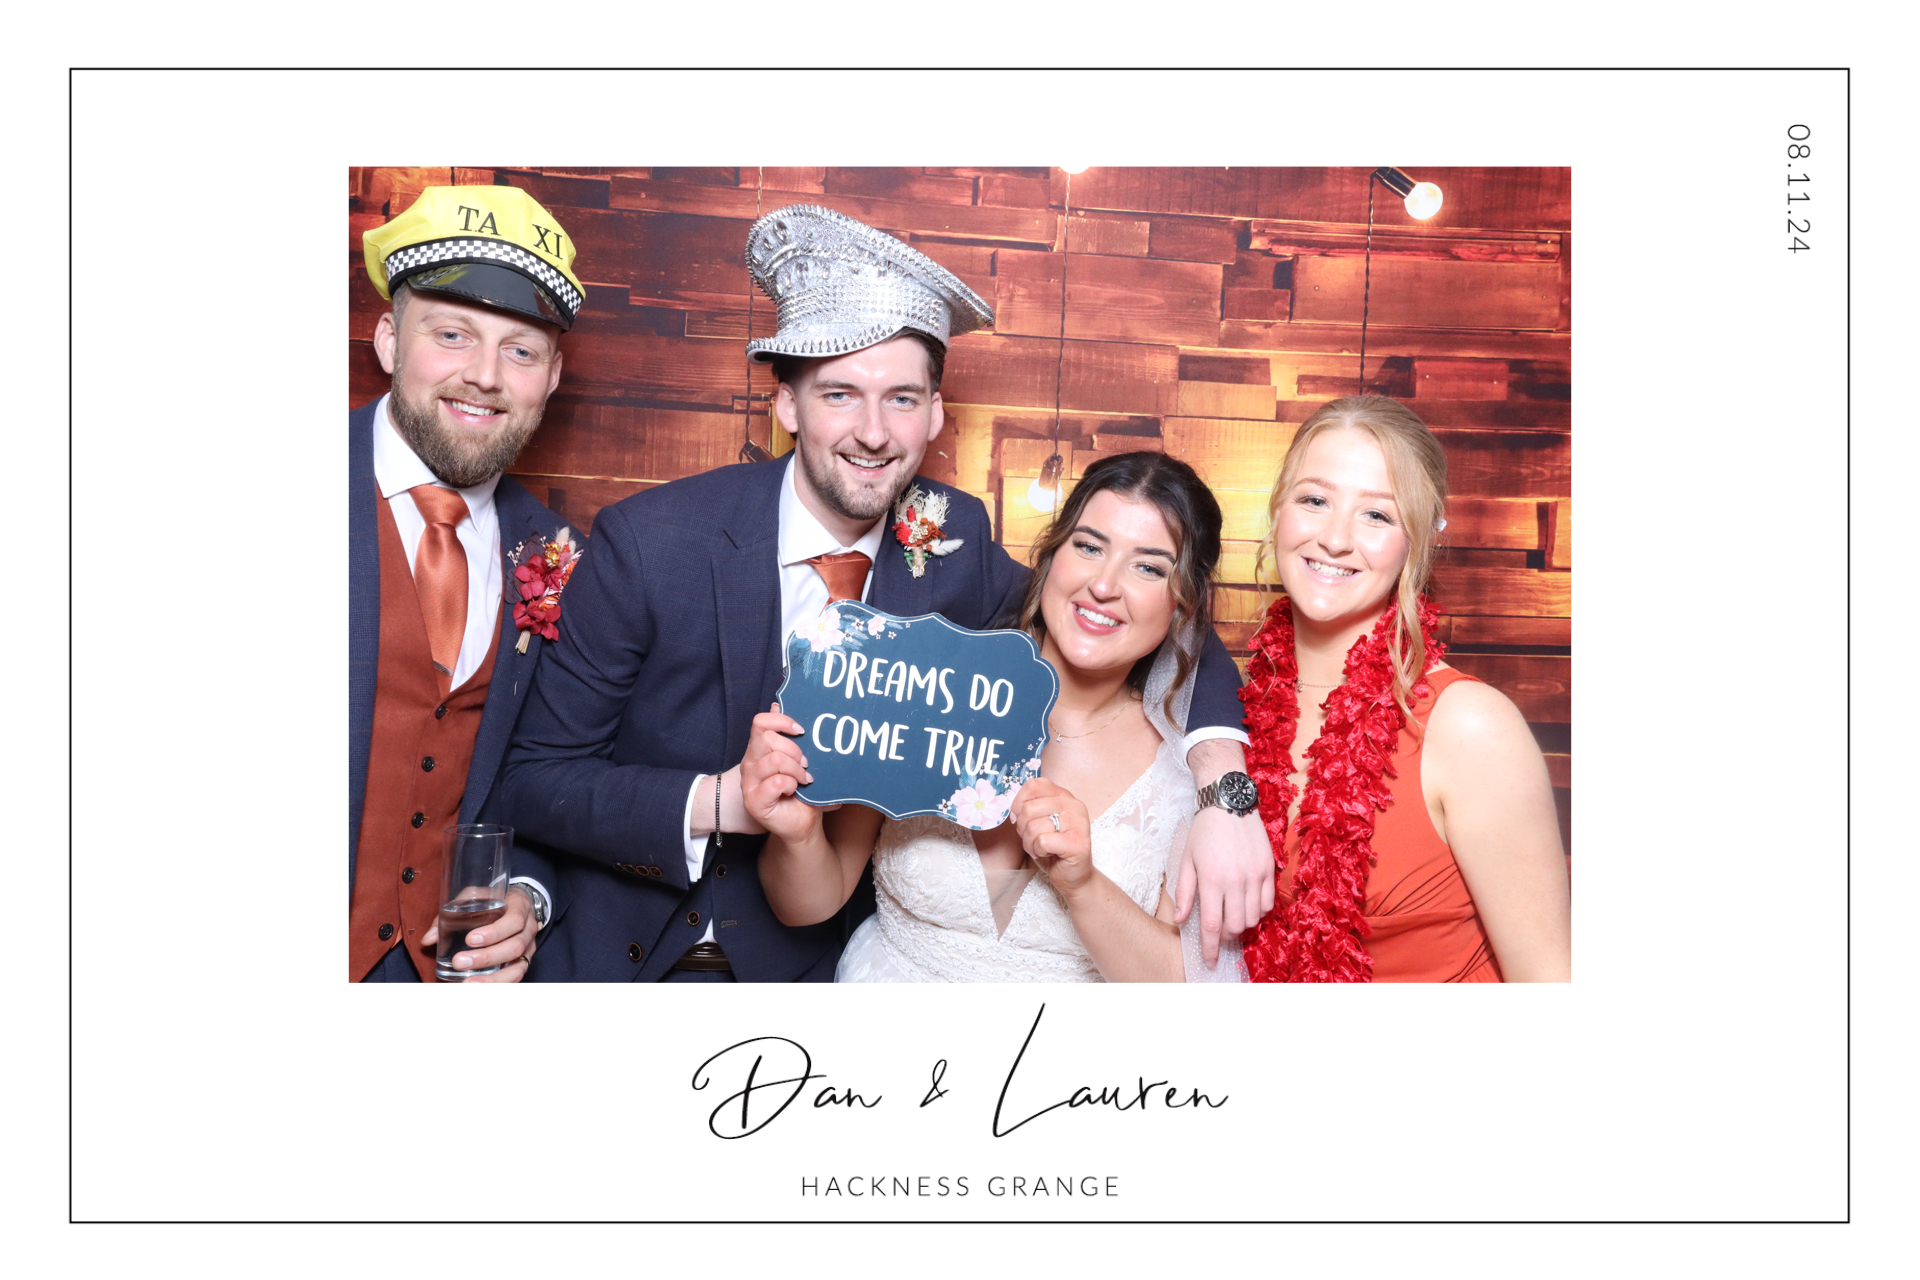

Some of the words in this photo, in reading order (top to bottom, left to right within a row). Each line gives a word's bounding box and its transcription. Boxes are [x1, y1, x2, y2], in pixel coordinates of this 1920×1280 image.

[823, 650, 955, 714] DREAMS
[969, 674, 1014, 717] DO
[812, 713, 909, 761] COME
[924, 727, 1005, 777] TRUE
